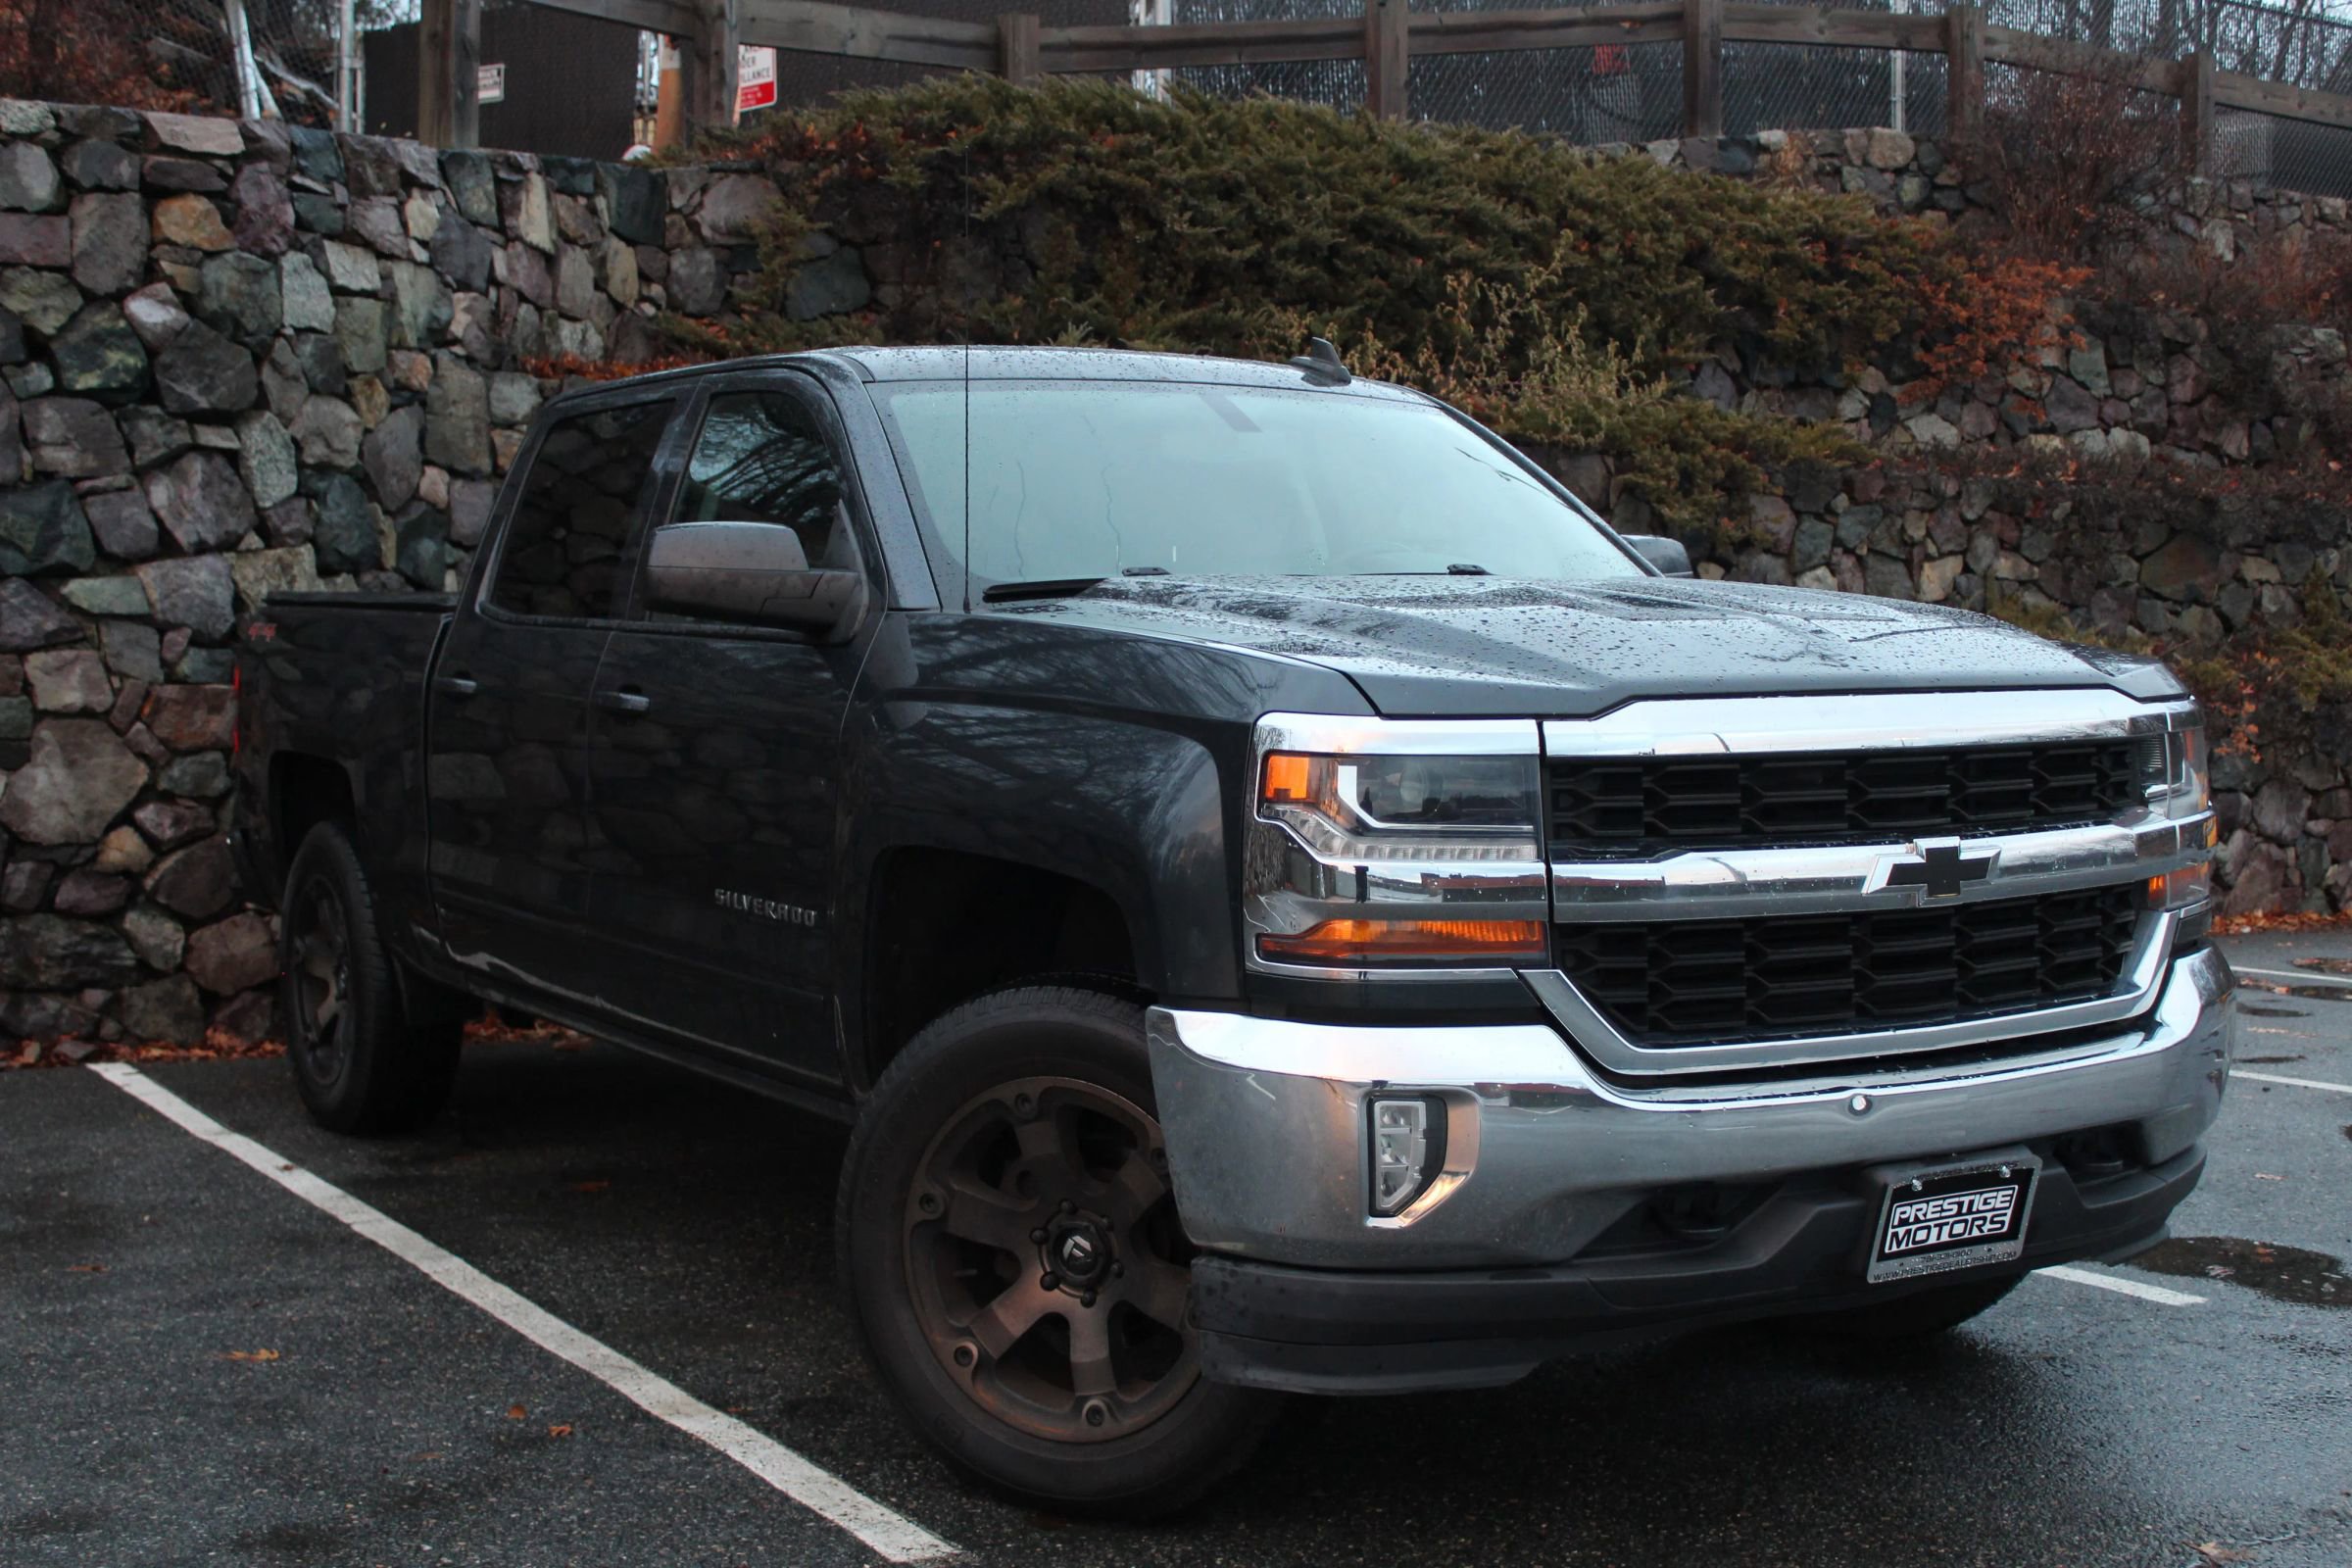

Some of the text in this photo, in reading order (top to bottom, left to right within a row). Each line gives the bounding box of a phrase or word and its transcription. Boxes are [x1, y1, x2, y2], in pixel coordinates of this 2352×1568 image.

[714, 888, 817, 927] SILVERADO
[1893, 1190, 2013, 1226] PRESTIGE
[1887, 1213, 2007, 1251] MOTORS
